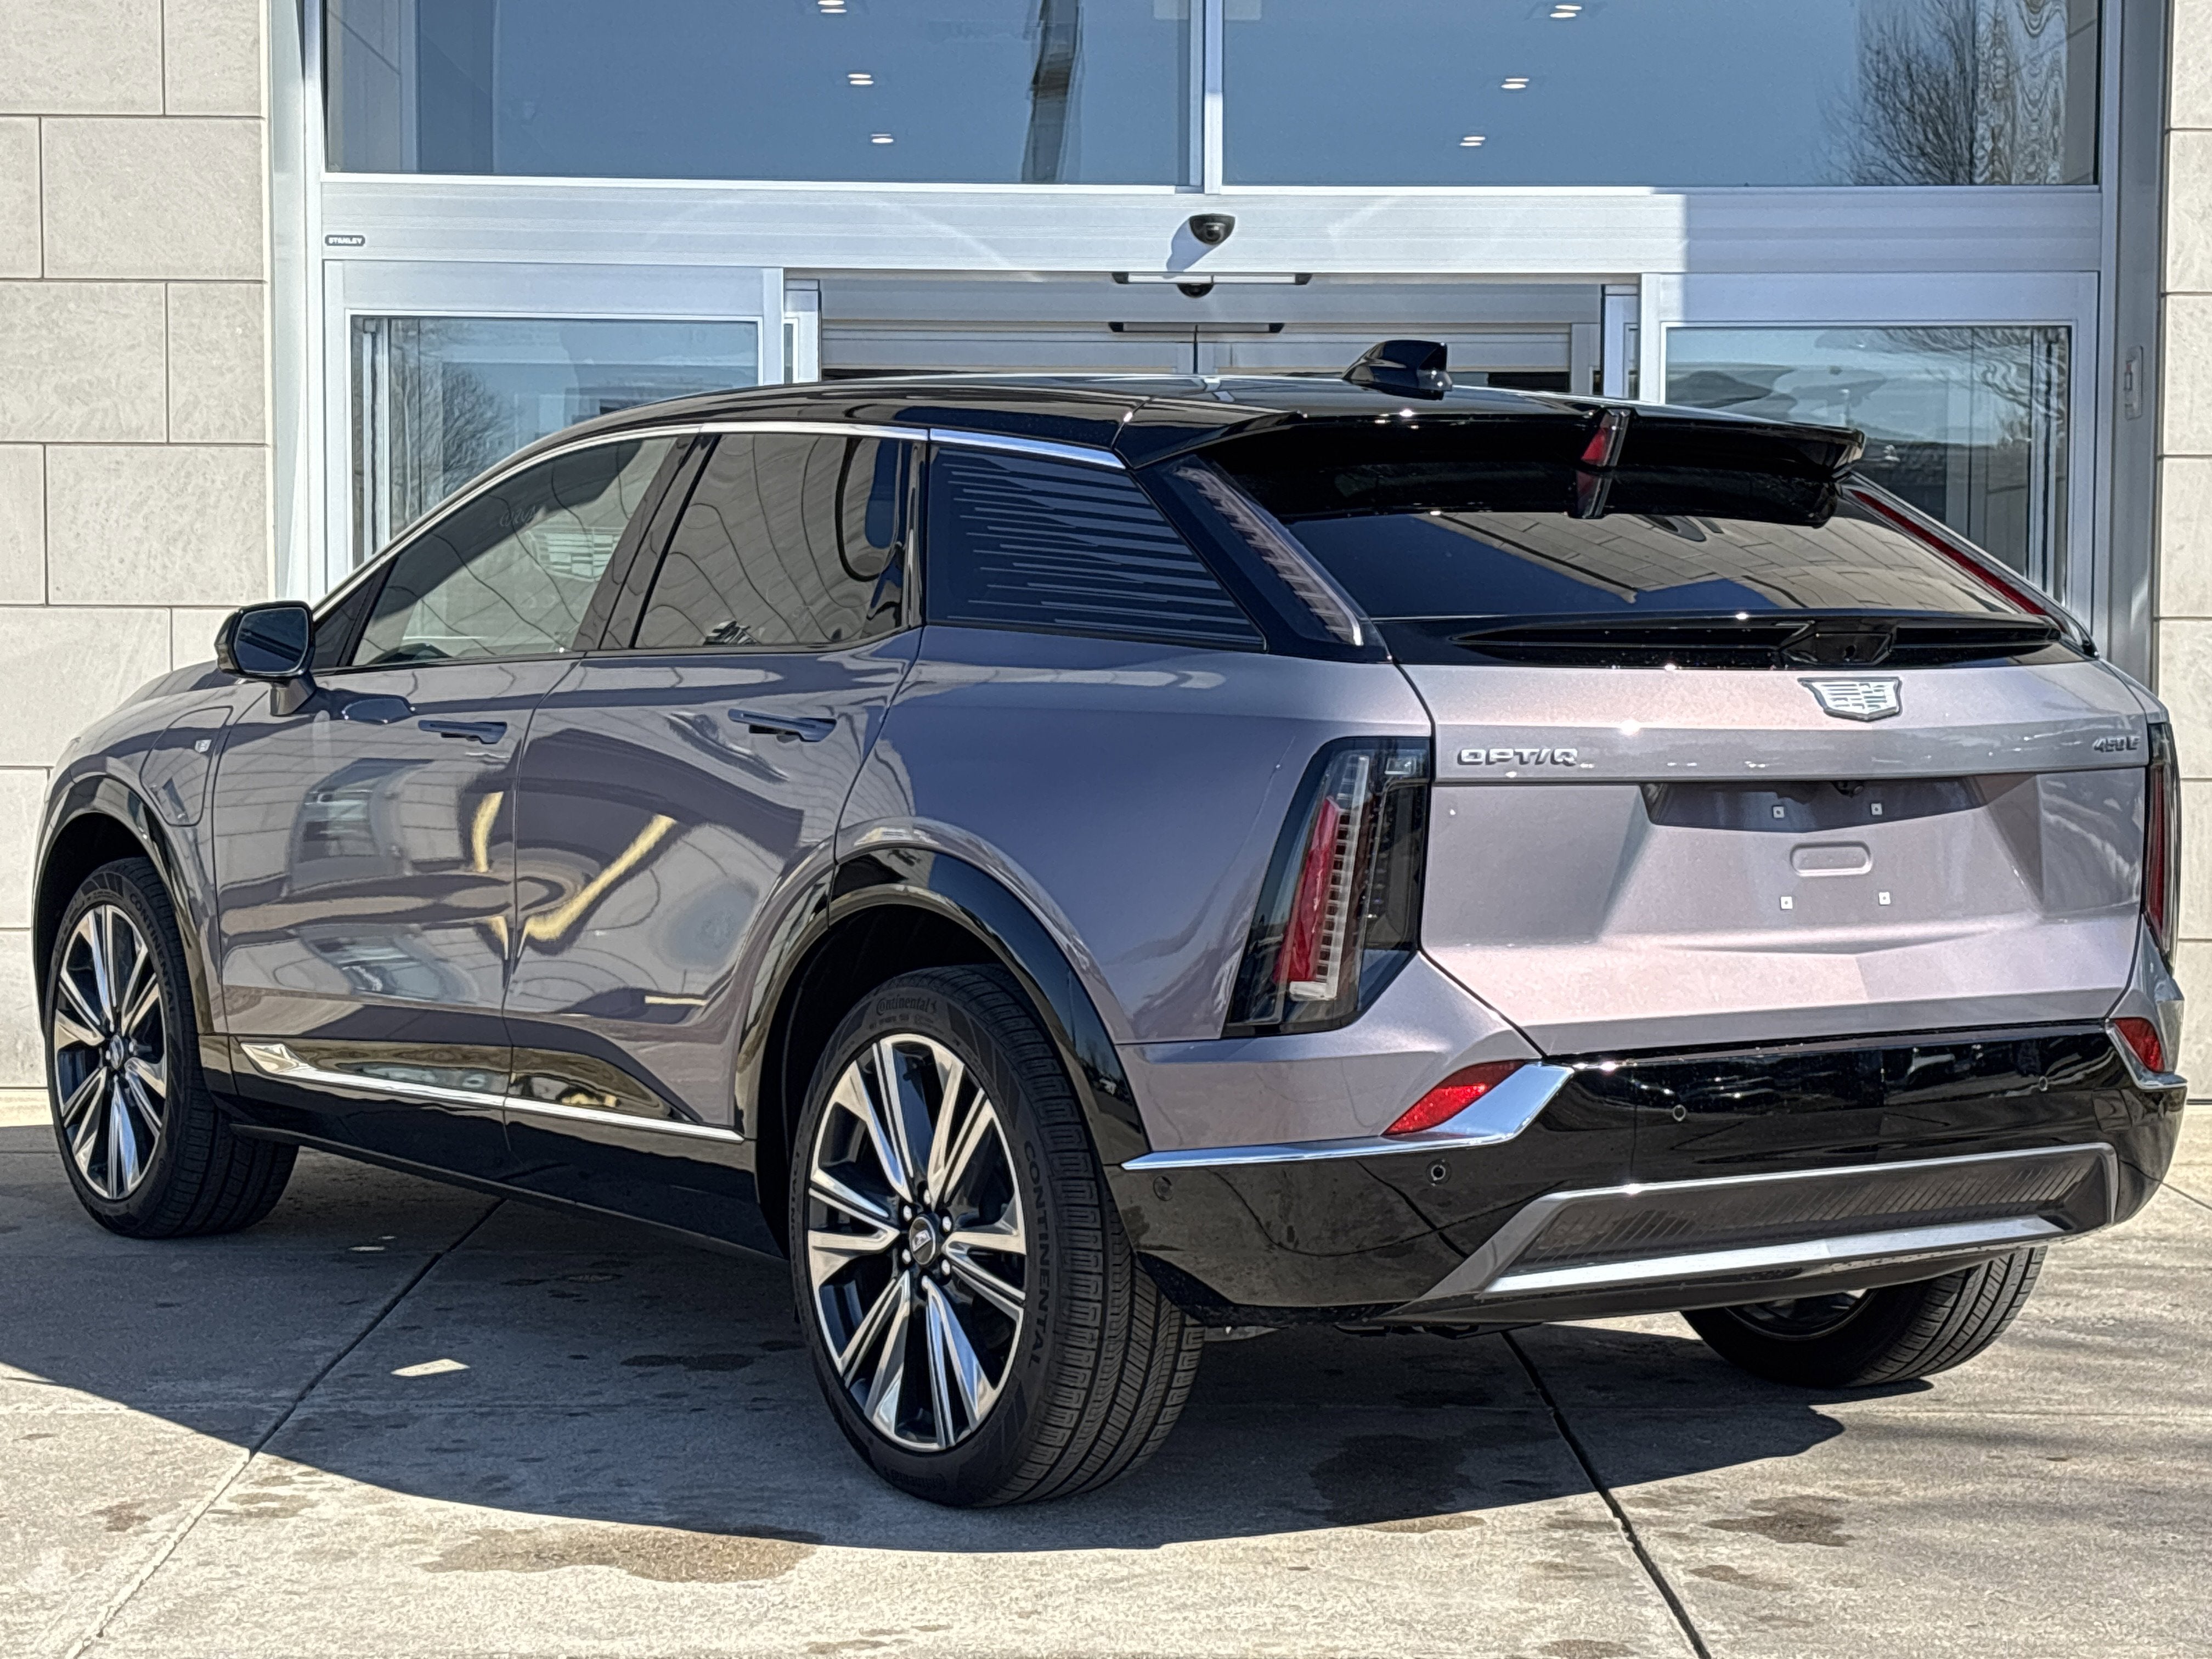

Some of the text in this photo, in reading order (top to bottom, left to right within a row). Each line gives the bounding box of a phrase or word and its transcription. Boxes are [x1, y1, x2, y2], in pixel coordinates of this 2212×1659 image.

[1457, 748, 1578, 766] OPTIQ
[876, 994, 930, 1015] Continental
[1024, 1141, 1049, 1369] CONTINENTAL
